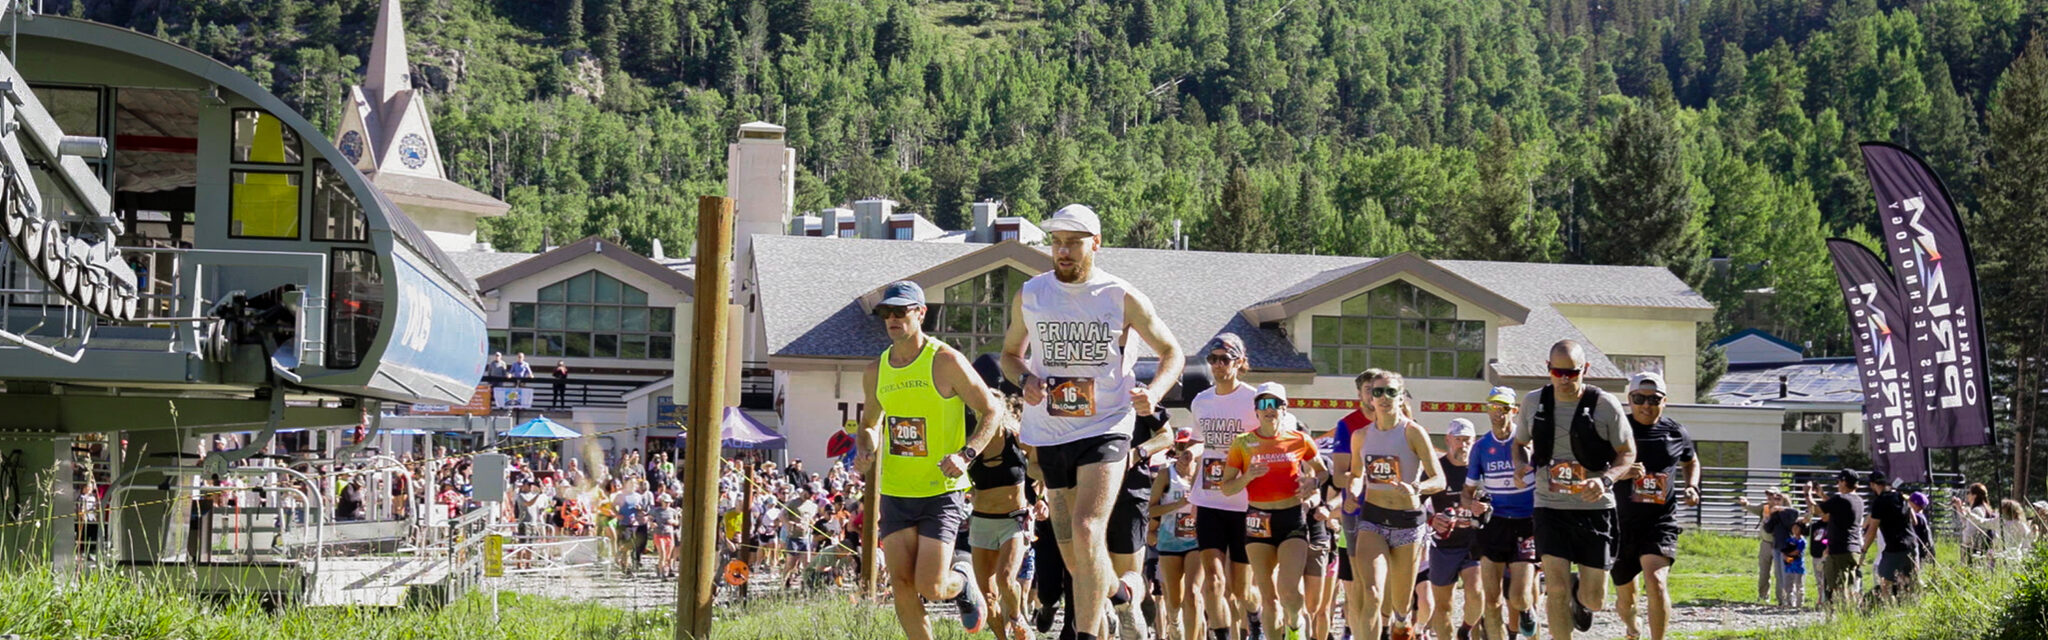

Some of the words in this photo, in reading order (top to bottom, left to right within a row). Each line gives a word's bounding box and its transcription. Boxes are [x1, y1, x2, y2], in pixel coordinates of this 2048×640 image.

[1036, 321, 1113, 342] PRIMAL
[1042, 341, 1108, 361] GENES
[880, 380, 930, 394] CREAMERS
[1062, 387, 1077, 403] 16
[896, 425, 918, 439] 206
[1199, 418, 1245, 434] PRIMAL
[1204, 432, 1237, 445] ENE
[1373, 462, 1391, 474] 279
[1487, 461, 1516, 471] ISRA
[1558, 467, 1572, 479] 29
[1643, 478, 1657, 489] 95
